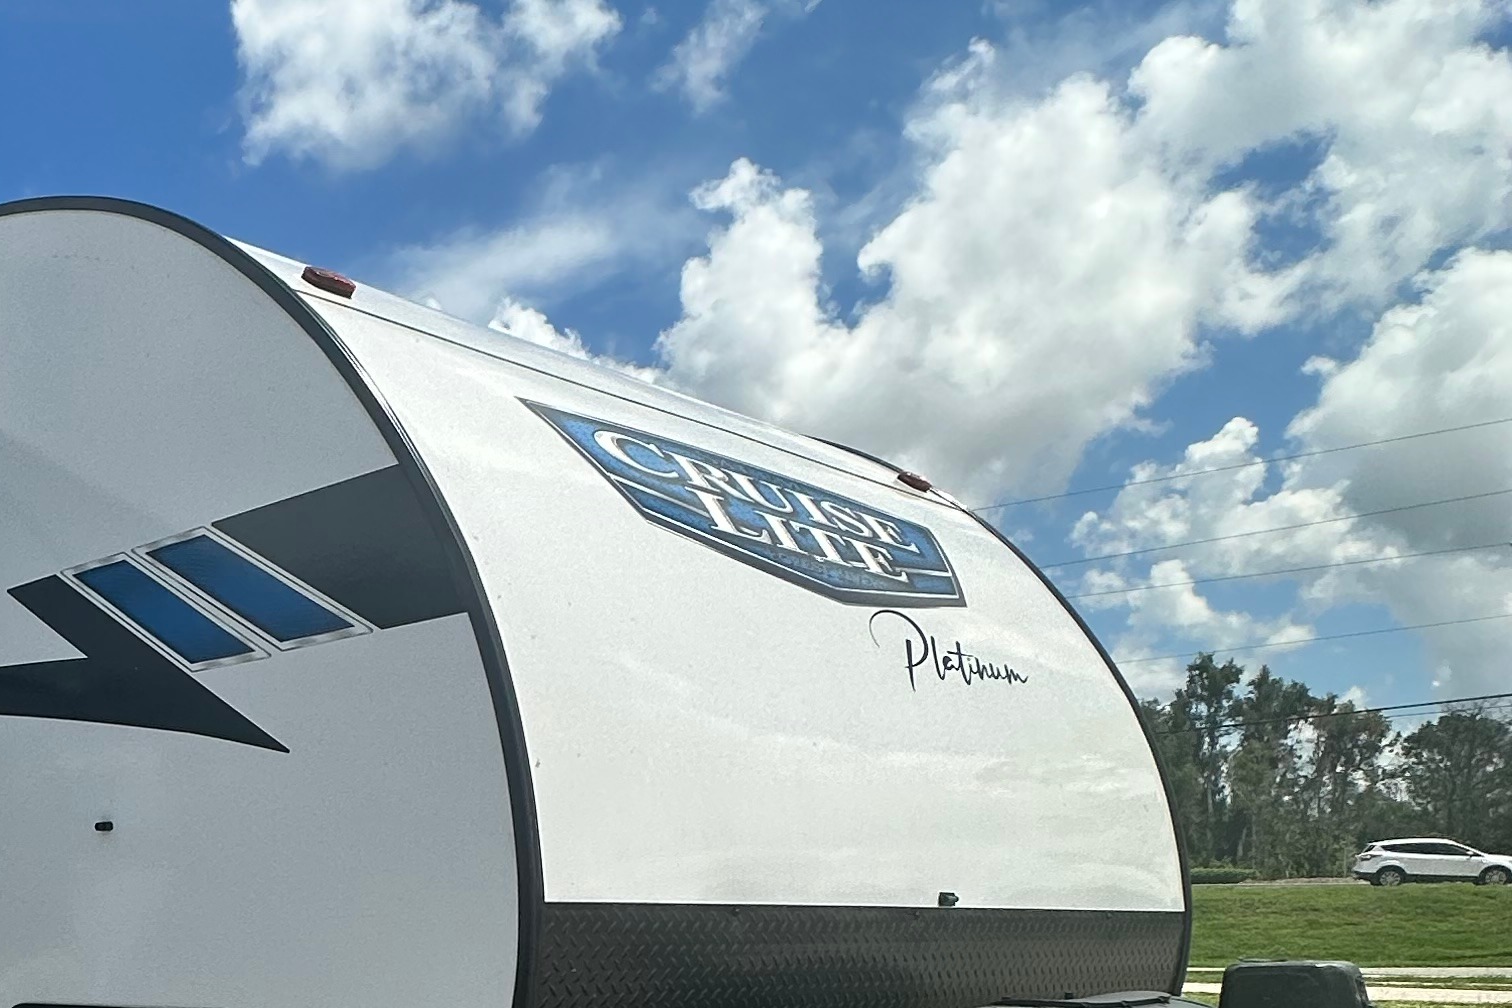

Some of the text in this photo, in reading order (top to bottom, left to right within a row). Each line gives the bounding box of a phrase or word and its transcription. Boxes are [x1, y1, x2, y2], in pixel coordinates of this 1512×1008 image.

[592, 429, 922, 554] CRUISE
[684, 483, 910, 583] LITE
[868, 609, 1029, 693] Platinum
